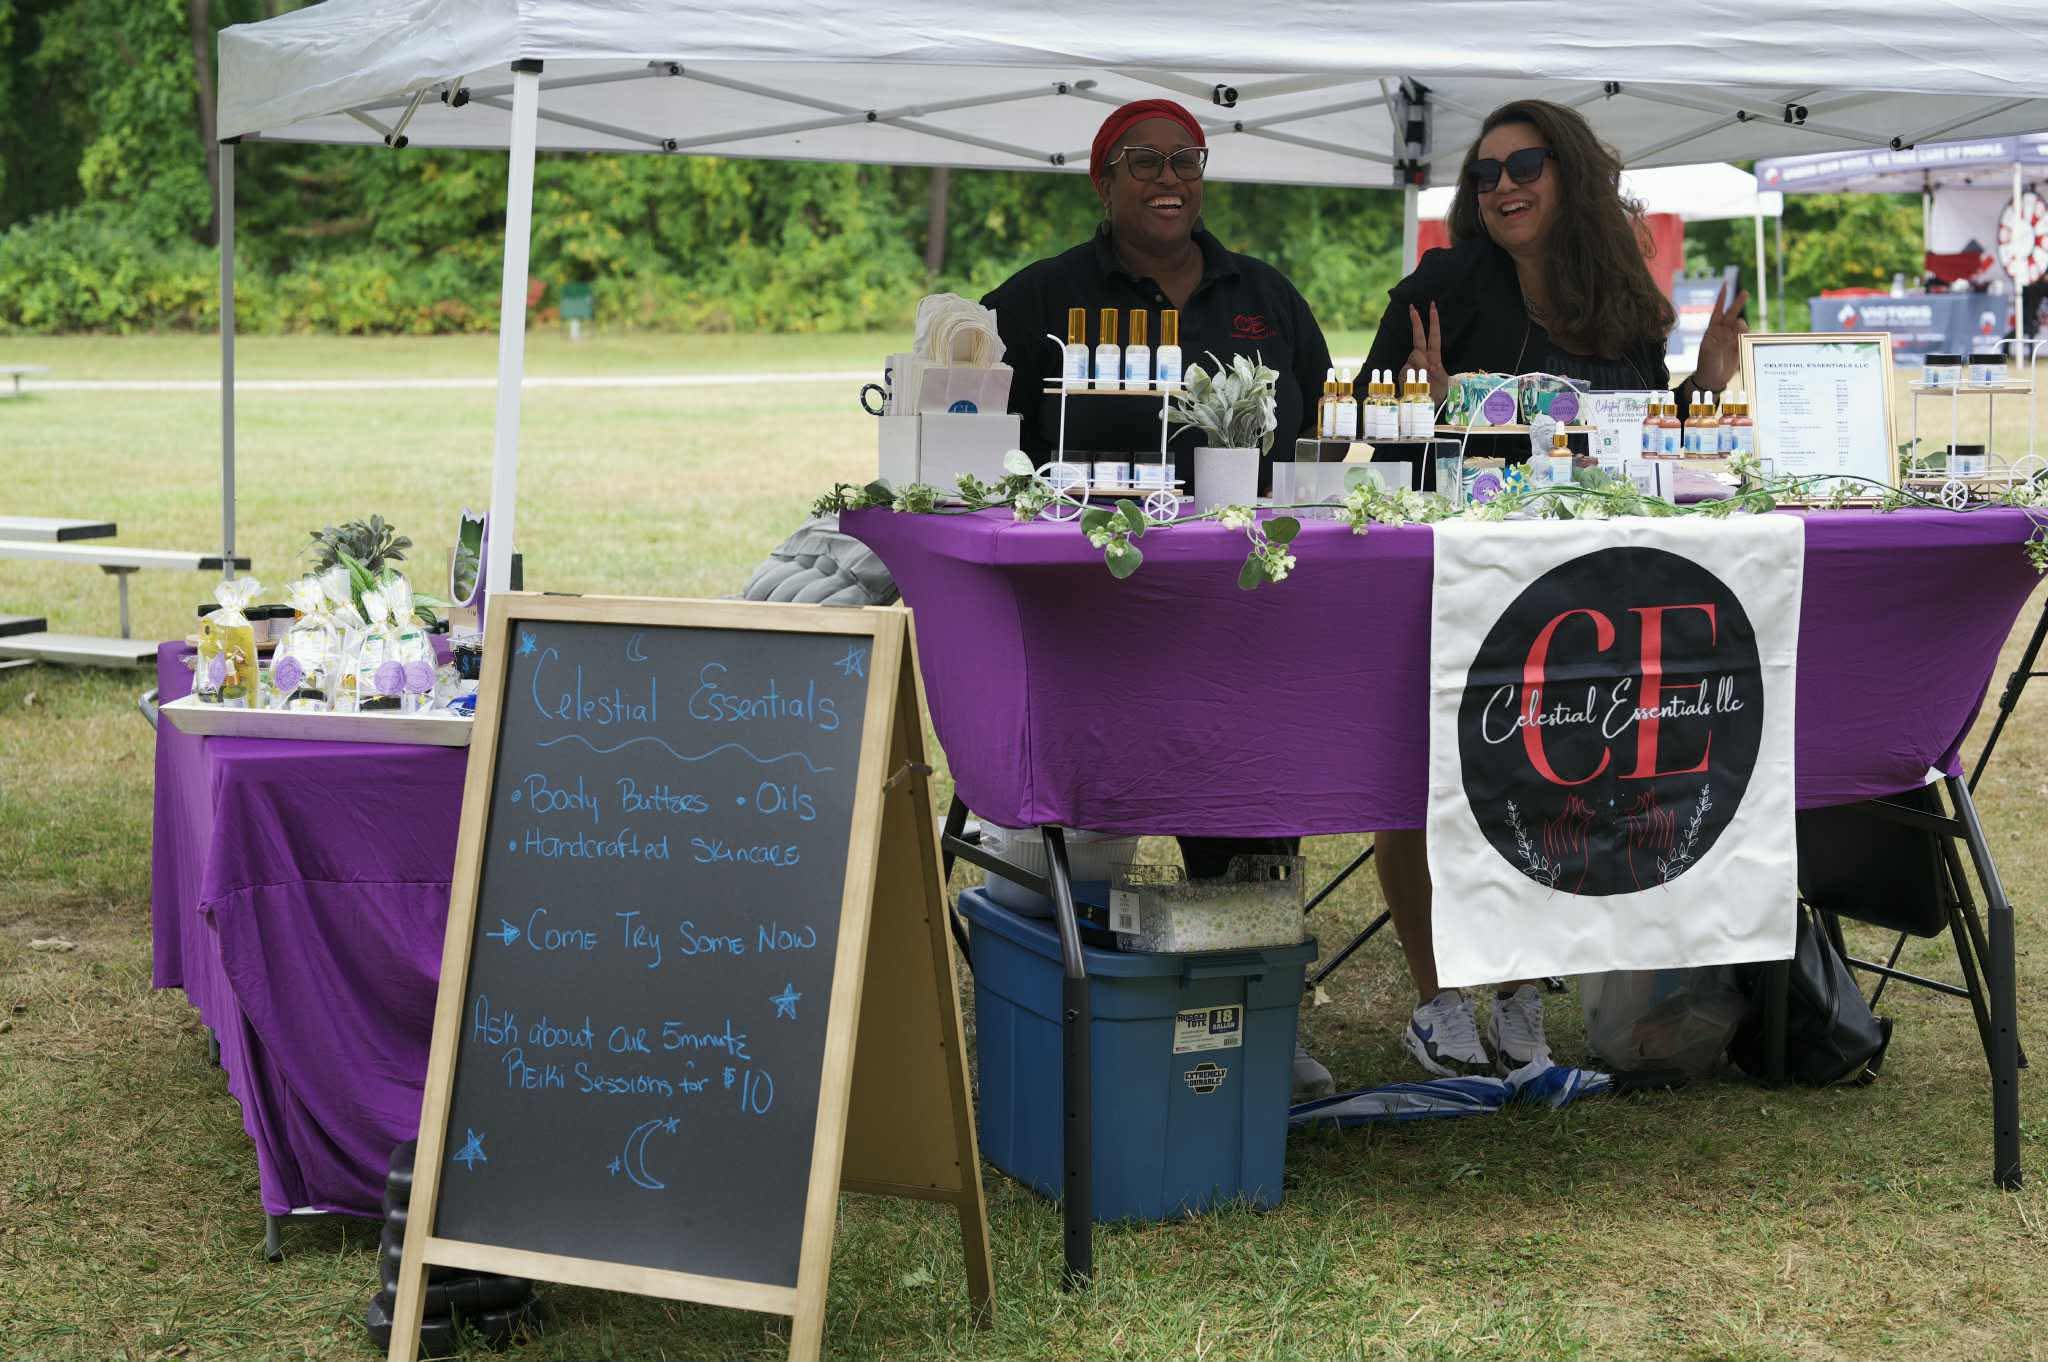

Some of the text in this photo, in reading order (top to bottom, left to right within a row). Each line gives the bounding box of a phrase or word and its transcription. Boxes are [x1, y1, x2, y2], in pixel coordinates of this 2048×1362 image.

[532, 648, 840, 732] Celestial Essentials
[1482, 675, 1745, 744] Celestial Essentials llc
[1520, 602, 1717, 786] CE
[523, 773, 600, 823] Body
[755, 780, 818, 821] Oils
[523, 826, 671, 861] Handcrafted
[473, 994, 519, 1046] Ask
[527, 1016, 594, 1050] about
[1216, 1009, 1233, 1023] 18
[573, 1061, 674, 1098] Sessions
[678, 1069, 710, 1094] for
[1185, 1069, 1226, 1080] EXTREMELY
[1189, 1077, 1221, 1087] DURABLE
